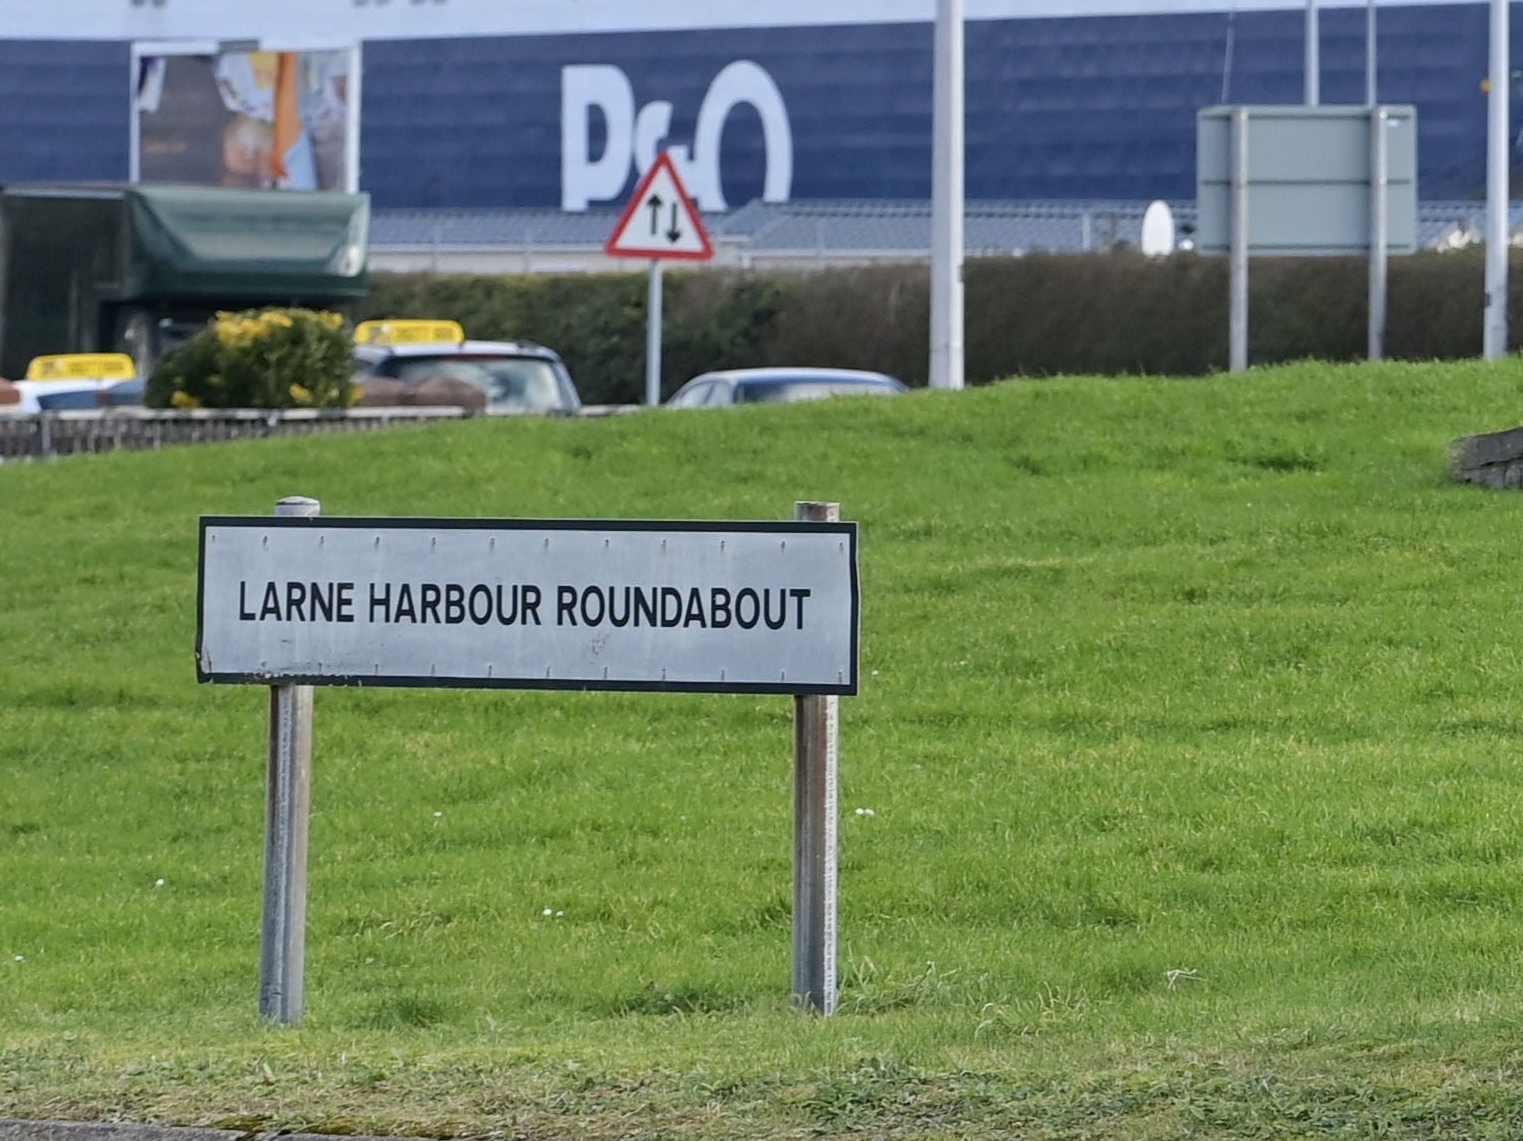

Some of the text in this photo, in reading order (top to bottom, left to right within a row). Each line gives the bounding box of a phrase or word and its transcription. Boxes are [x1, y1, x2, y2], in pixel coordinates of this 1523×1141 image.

[238, 580, 812, 630] LARNE HARBOUR ROUNDABOUT
